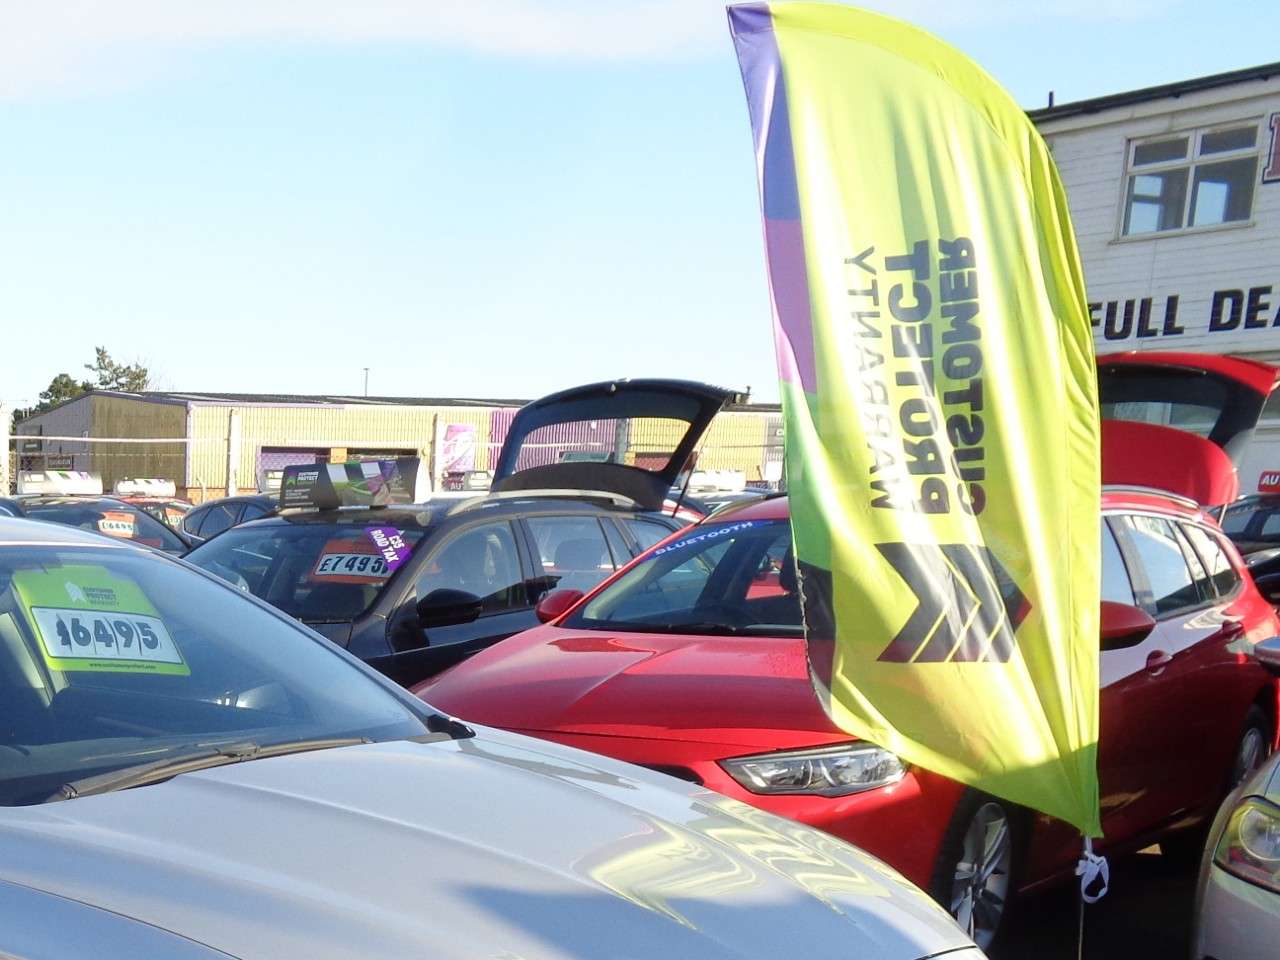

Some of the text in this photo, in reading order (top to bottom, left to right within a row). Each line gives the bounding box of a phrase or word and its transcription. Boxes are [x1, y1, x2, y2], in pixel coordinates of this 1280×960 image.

[1209, 285, 1280, 332] DE
[370, 529, 400, 563] ROAD TAX
[655, 521, 753, 555] BLUETOOTH
